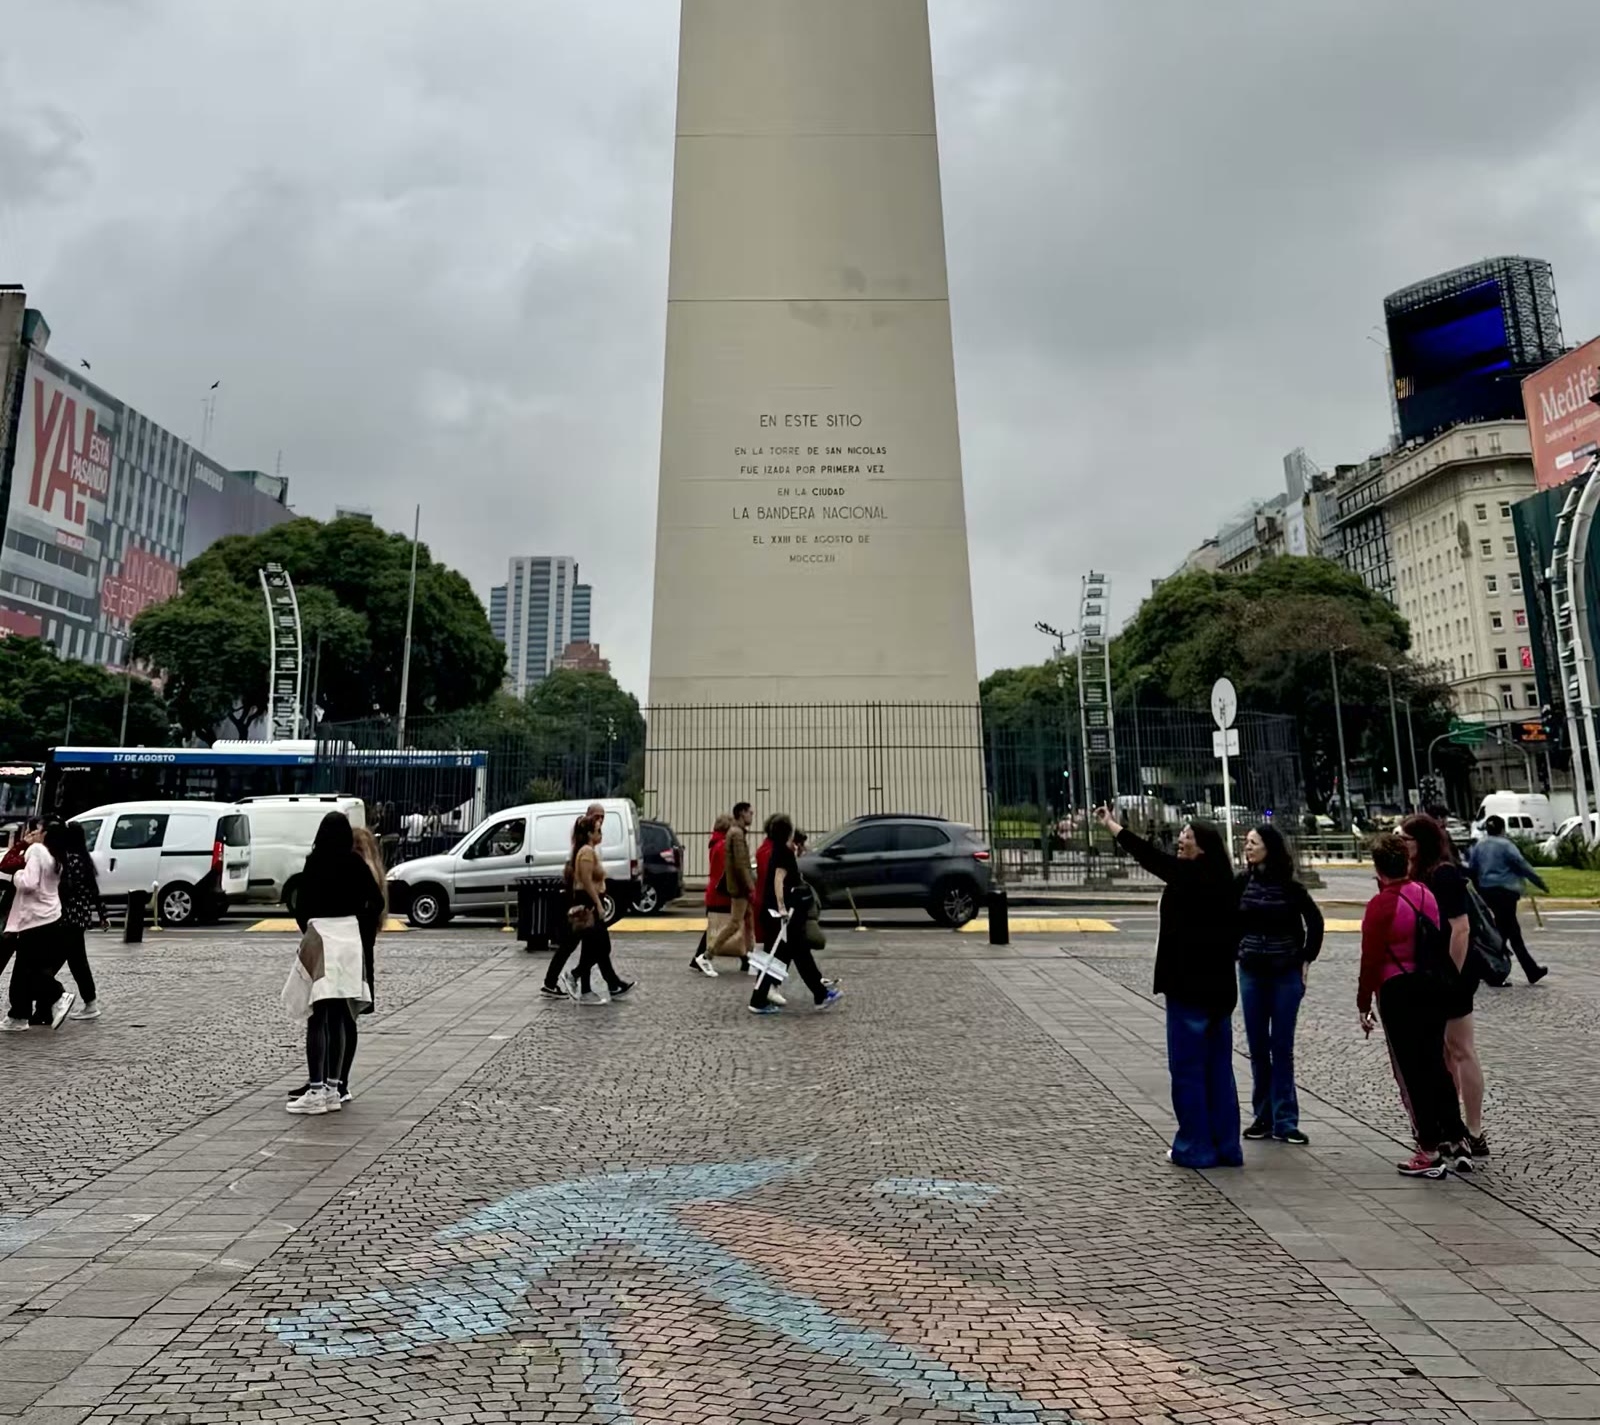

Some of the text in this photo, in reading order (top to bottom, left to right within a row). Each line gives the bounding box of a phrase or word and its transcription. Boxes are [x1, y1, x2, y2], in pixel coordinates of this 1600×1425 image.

[1540, 365, 1597, 426] Medifé
[760, 415, 862, 427] EN ESTE SITIO
[89, 434, 111, 467] ESTÁ
[734, 447, 887, 455] EN LA TORRE DE SAN NICOLAS
[71, 454, 109, 493] PASANDO
[741, 465, 884, 474] FUE IZADA POR PRIMERA VEZ
[778, 488, 845, 496] EN LA CIUDAD
[733, 507, 888, 519] LA BANDERA NACIONAL
[753, 536, 764, 544] EL
[796, 536, 807, 544] DE
[814, 535, 853, 544] AGOSTO
[858, 535, 870, 543] DE
[113, 754, 176, 762] 17 DE AGOSTO
